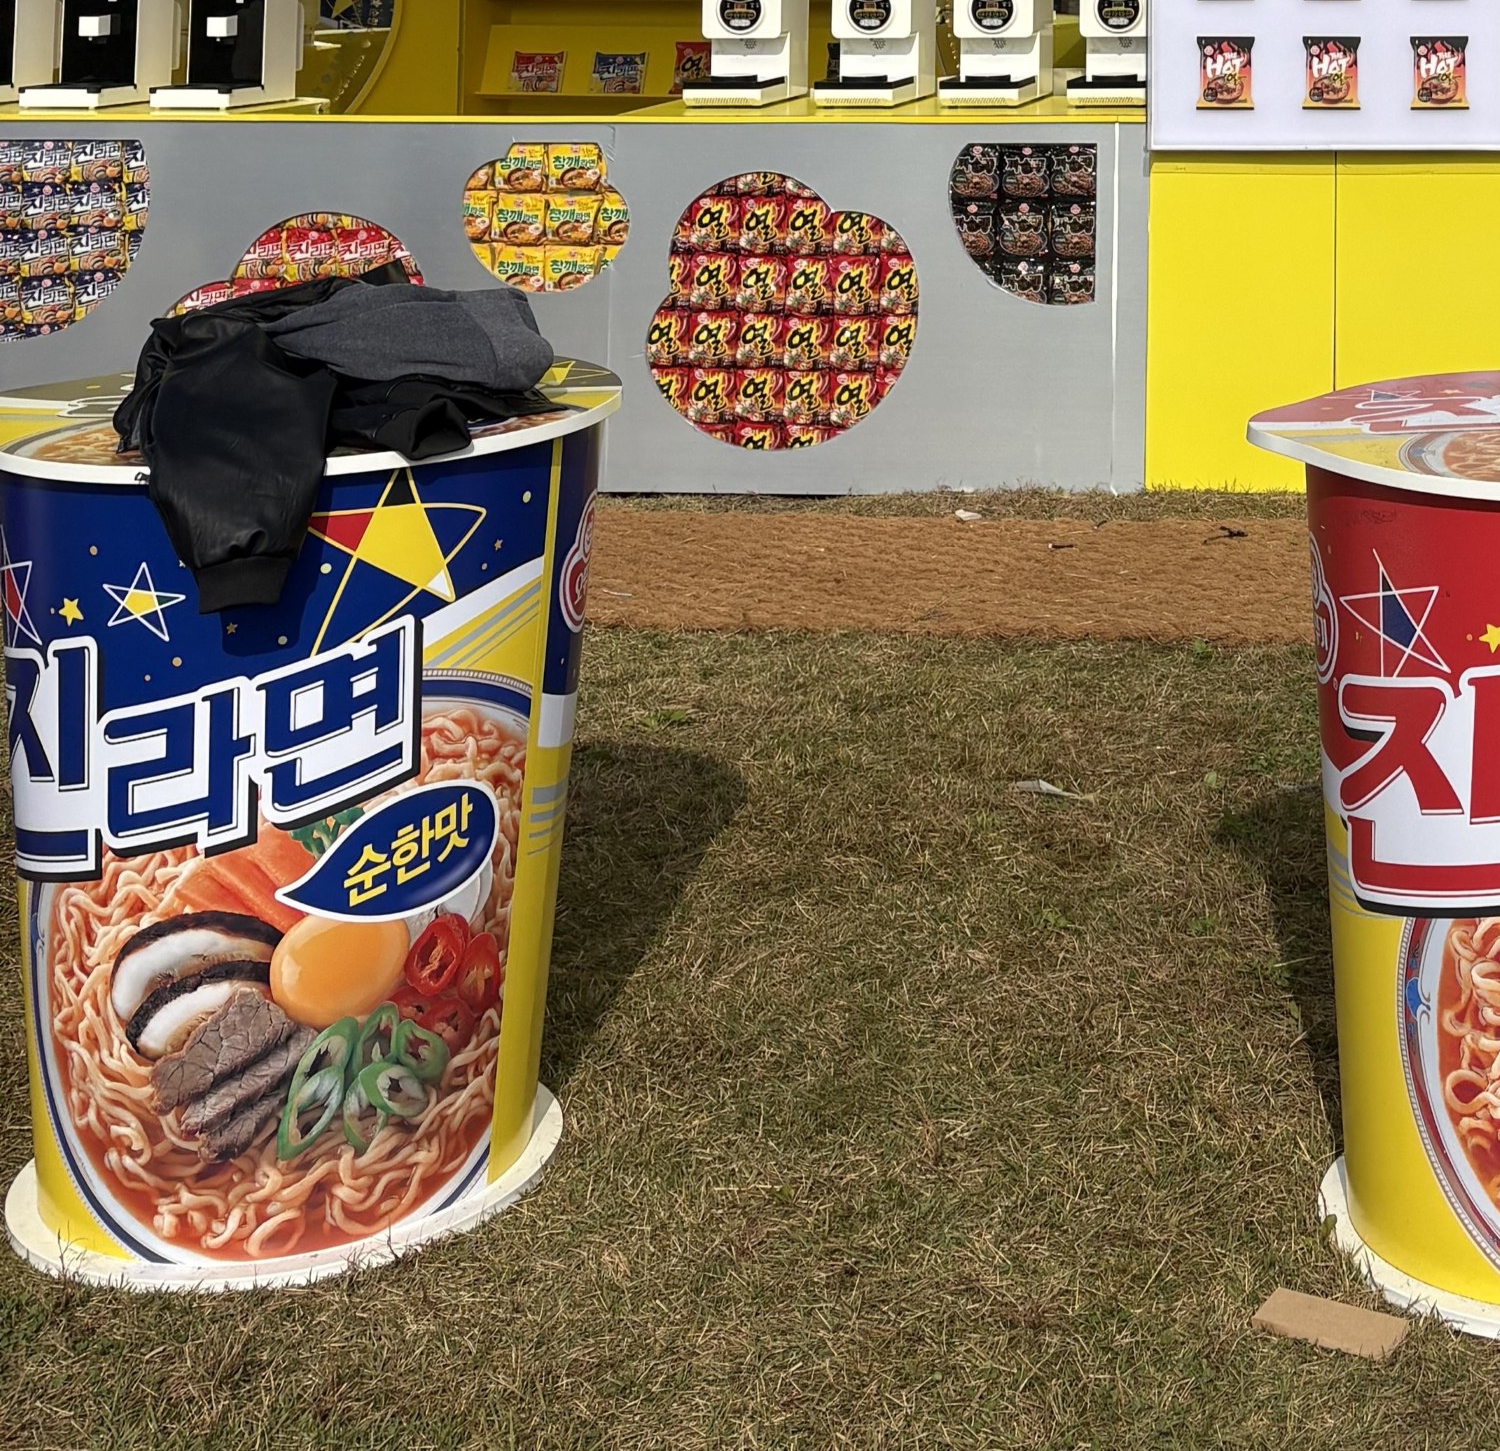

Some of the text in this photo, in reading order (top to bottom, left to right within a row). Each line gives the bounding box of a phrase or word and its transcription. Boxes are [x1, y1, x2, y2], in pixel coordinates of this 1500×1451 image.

[1206, 53, 1244, 80] HOT
[1312, 53, 1350, 80] HOT
[1420, 53, 1458, 80] HOT
[72, 141, 121, 165] 진라면
[552, 155, 597, 170] 참깨라면
[496, 208, 539, 223] 참깨라면
[548, 207, 591, 223] 참깨라면
[696, 207, 729, 239] 열
[745, 208, 778, 242] 열
[789, 208, 824, 241] 열
[19, 239, 68, 263] 진라면
[70, 234, 119, 257] 진라면
[497, 259, 540, 275] 참깨라면
[550, 259, 594, 274] 참깨라면
[695, 265, 729, 298] 열
[792, 265, 825, 299] 열
[23, 286, 71, 311] 진라면
[742, 267, 775, 300] 열
[838, 270, 872, 304] 열
[649, 322, 680, 355] 열
[694, 325, 728, 358] 열
[741, 324, 775, 357] 열
[787, 327, 821, 360] 열
[836, 327, 869, 360] 열
[693, 379, 727, 412] 열
[741, 377, 775, 410] 열
[786, 378, 821, 411] 열
[834, 383, 869, 417] 열
[5, 616, 422, 879] 진라면
[343, 793, 474, 908] 순한맛
